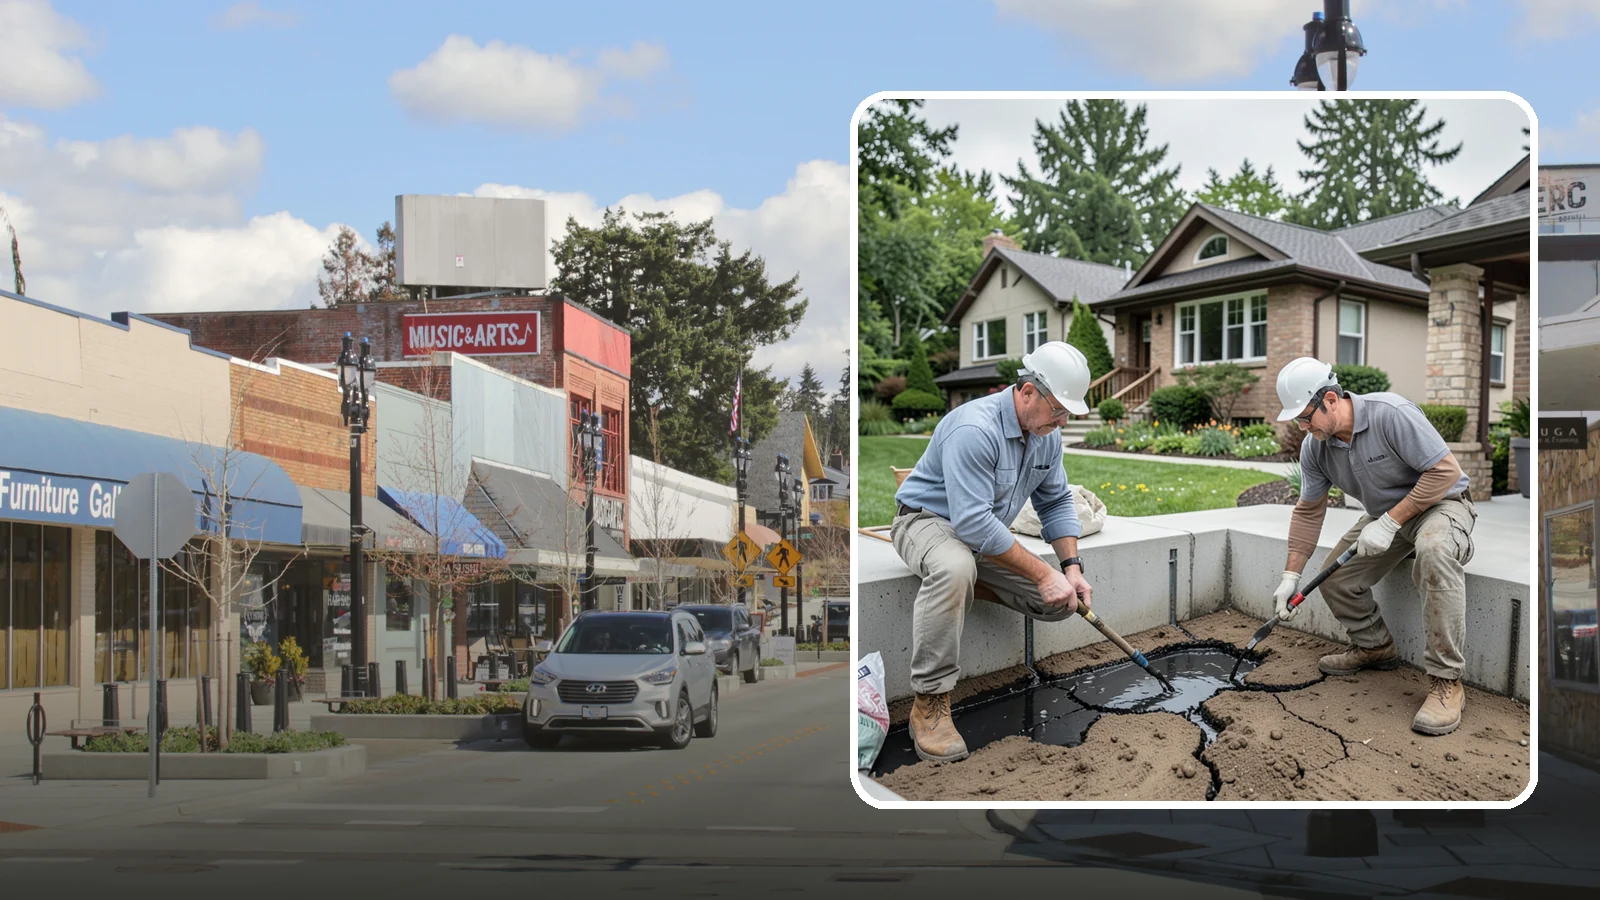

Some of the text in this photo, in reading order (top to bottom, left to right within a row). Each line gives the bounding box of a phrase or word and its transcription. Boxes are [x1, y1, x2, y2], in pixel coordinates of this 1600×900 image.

[0, 471, 121, 519] Furniture Gal
[453, 563, 479, 574] SUSHI
